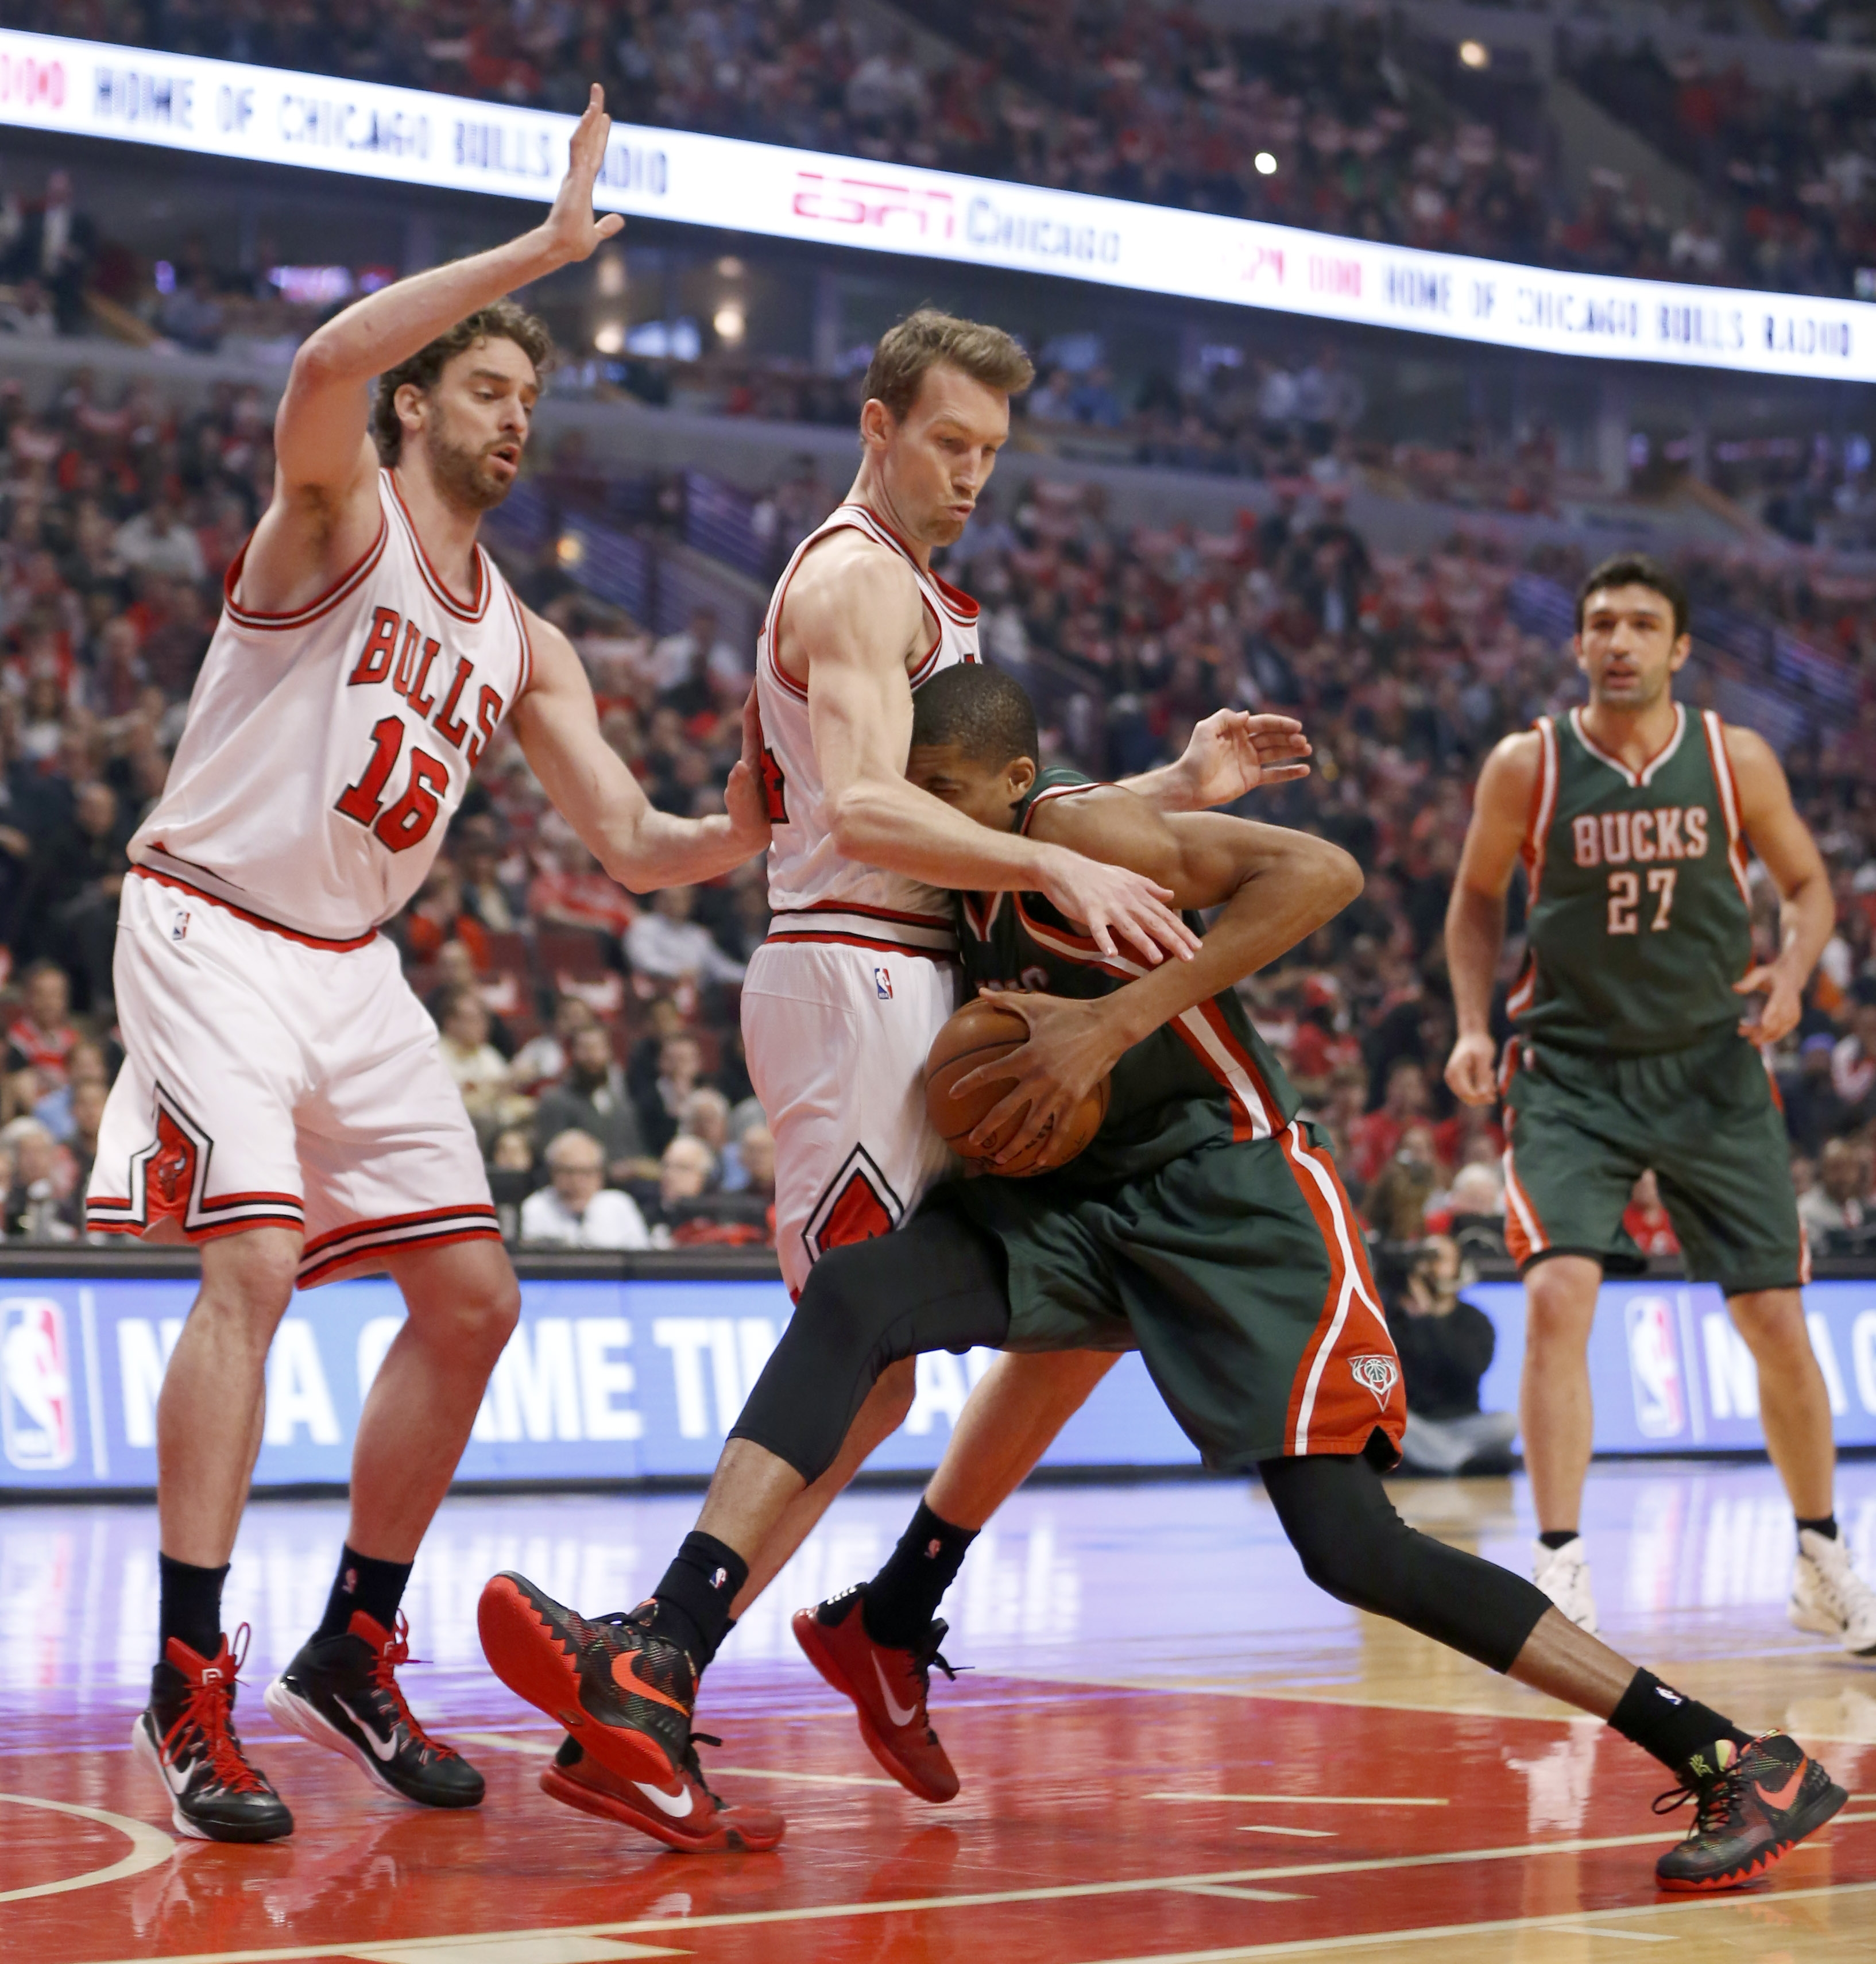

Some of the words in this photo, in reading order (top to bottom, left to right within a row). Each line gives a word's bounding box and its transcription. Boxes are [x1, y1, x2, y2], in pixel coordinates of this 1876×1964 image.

[95, 64, 195, 132] HOME
[218, 84, 255, 134] OF
[455, 119, 551, 179] BULLS
[792, 171, 954, 239] ESPN
[1385, 263, 1453, 317] HOME
[1471, 280, 1495, 320] OF
[1661, 304, 1746, 349] BULLS
[1765, 314, 1850, 357] RADIO
[347, 606, 504, 771] BULLS
[334, 715, 450, 853] 16
[1572, 805, 1709, 868] BUCKS
[1607, 868, 1678, 935] 27
[117, 1317, 342, 1448] NA
